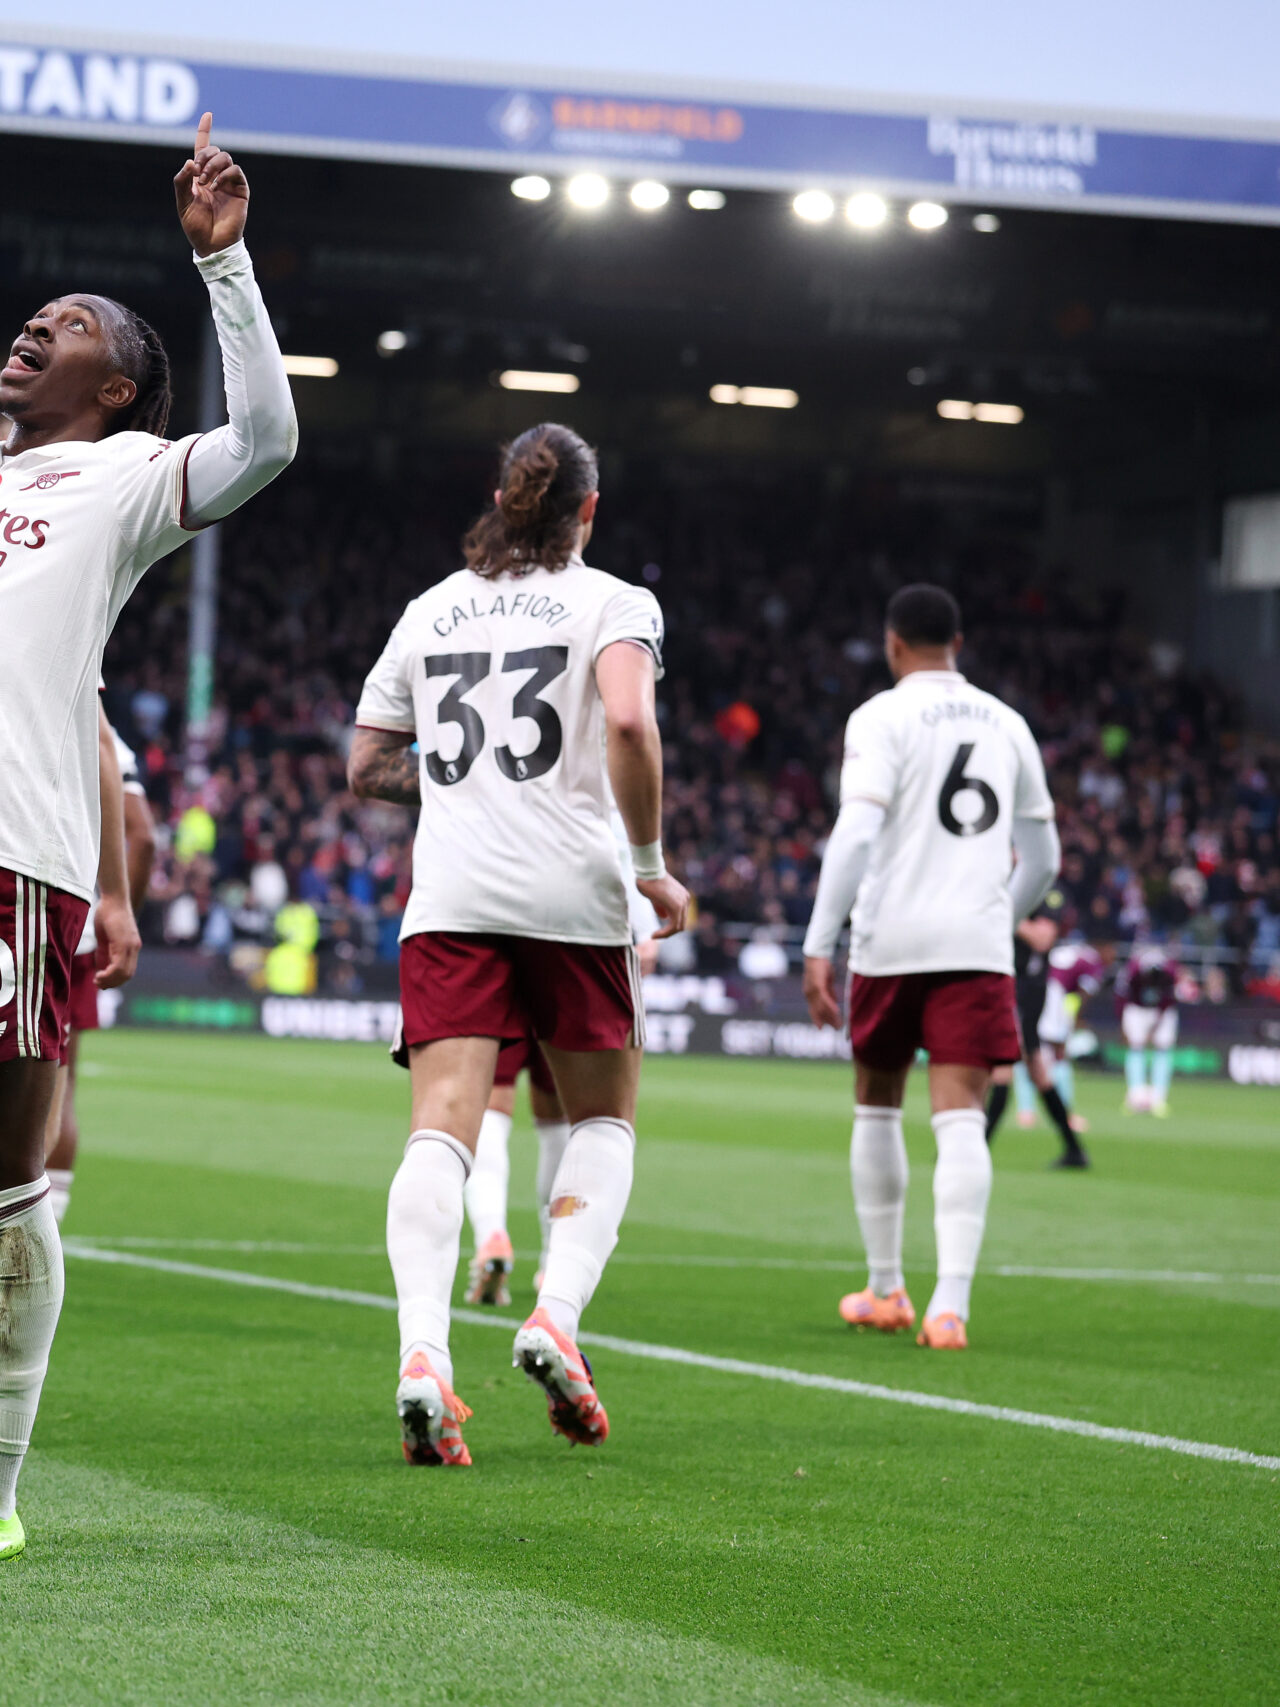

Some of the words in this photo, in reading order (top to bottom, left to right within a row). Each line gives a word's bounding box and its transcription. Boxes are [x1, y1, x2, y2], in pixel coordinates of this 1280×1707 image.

[433, 592, 572, 637] CALAFIORI
[424, 645, 569, 786] 33
[938, 742, 999, 837] 6
